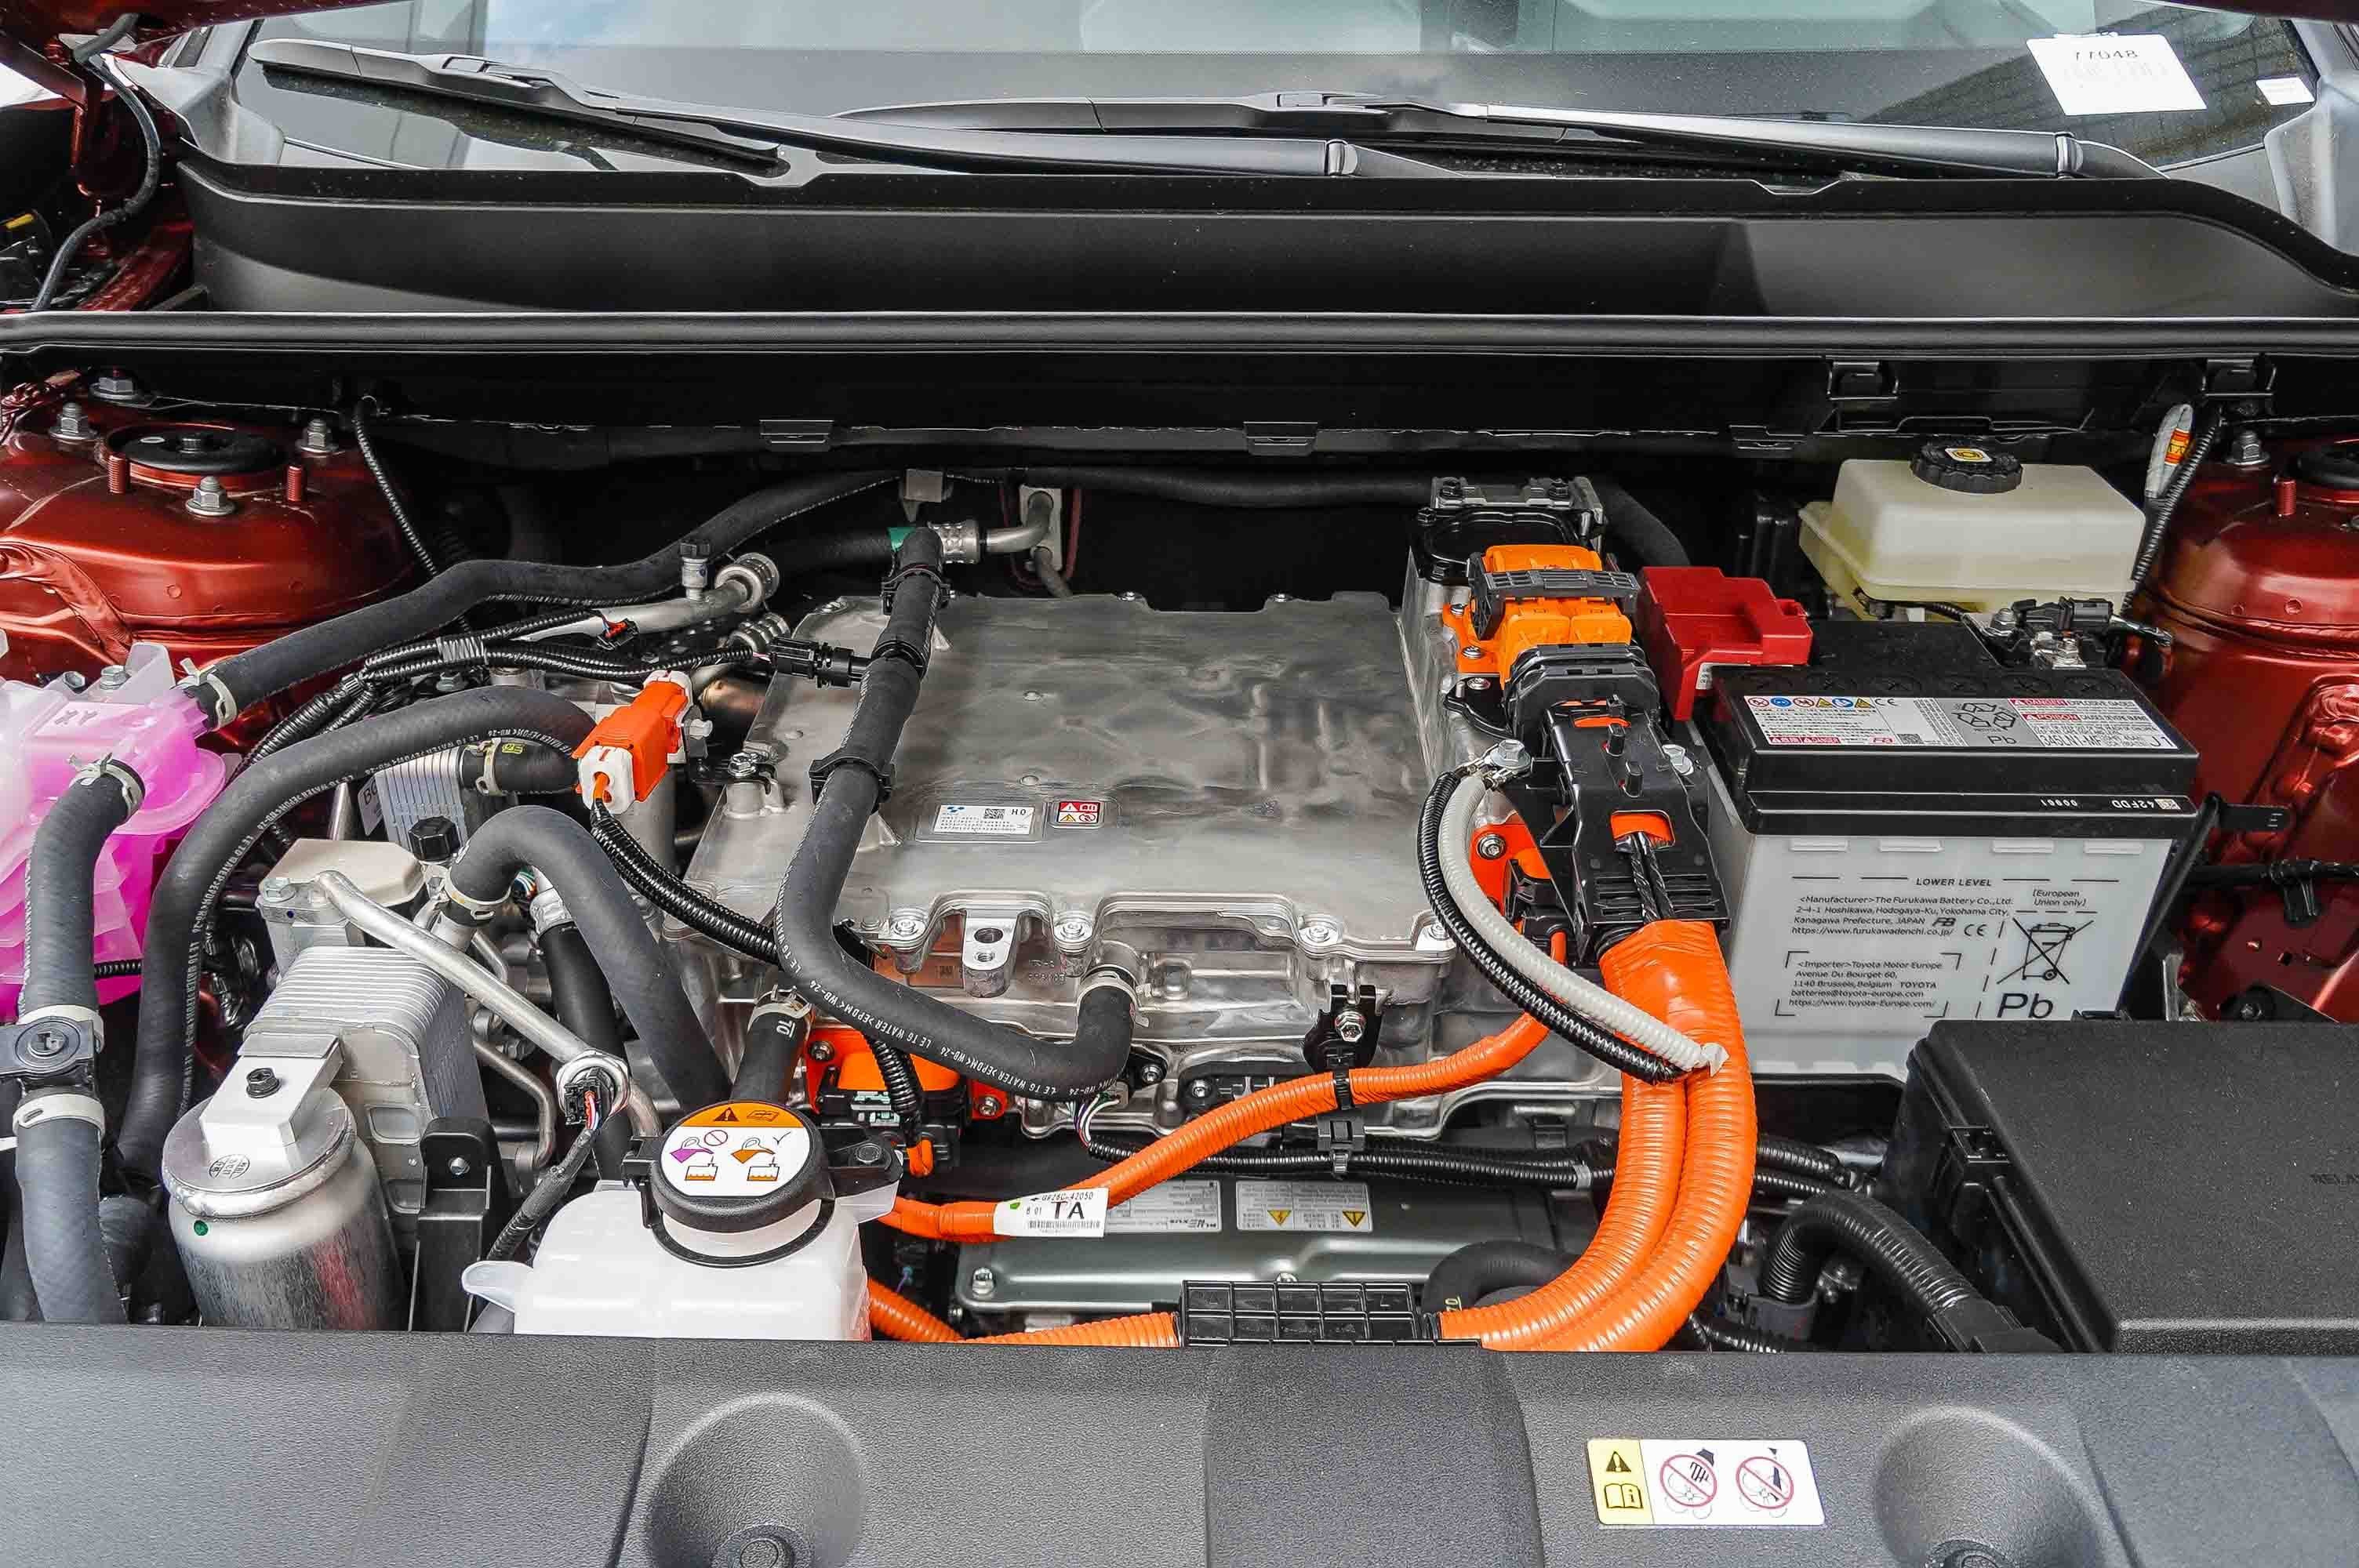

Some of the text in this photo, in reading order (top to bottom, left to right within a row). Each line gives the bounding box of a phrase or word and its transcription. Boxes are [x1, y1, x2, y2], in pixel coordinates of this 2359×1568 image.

[1916, 878, 1992, 887] LOWER LEVEL
[1939, 897, 1976, 906] Battery
[1997, 993, 2055, 1018] Pb
[875, 1019, 905, 1040] WATER
[998, 1071, 1027, 1091] WATER
[1051, 1201, 1085, 1220] TA
